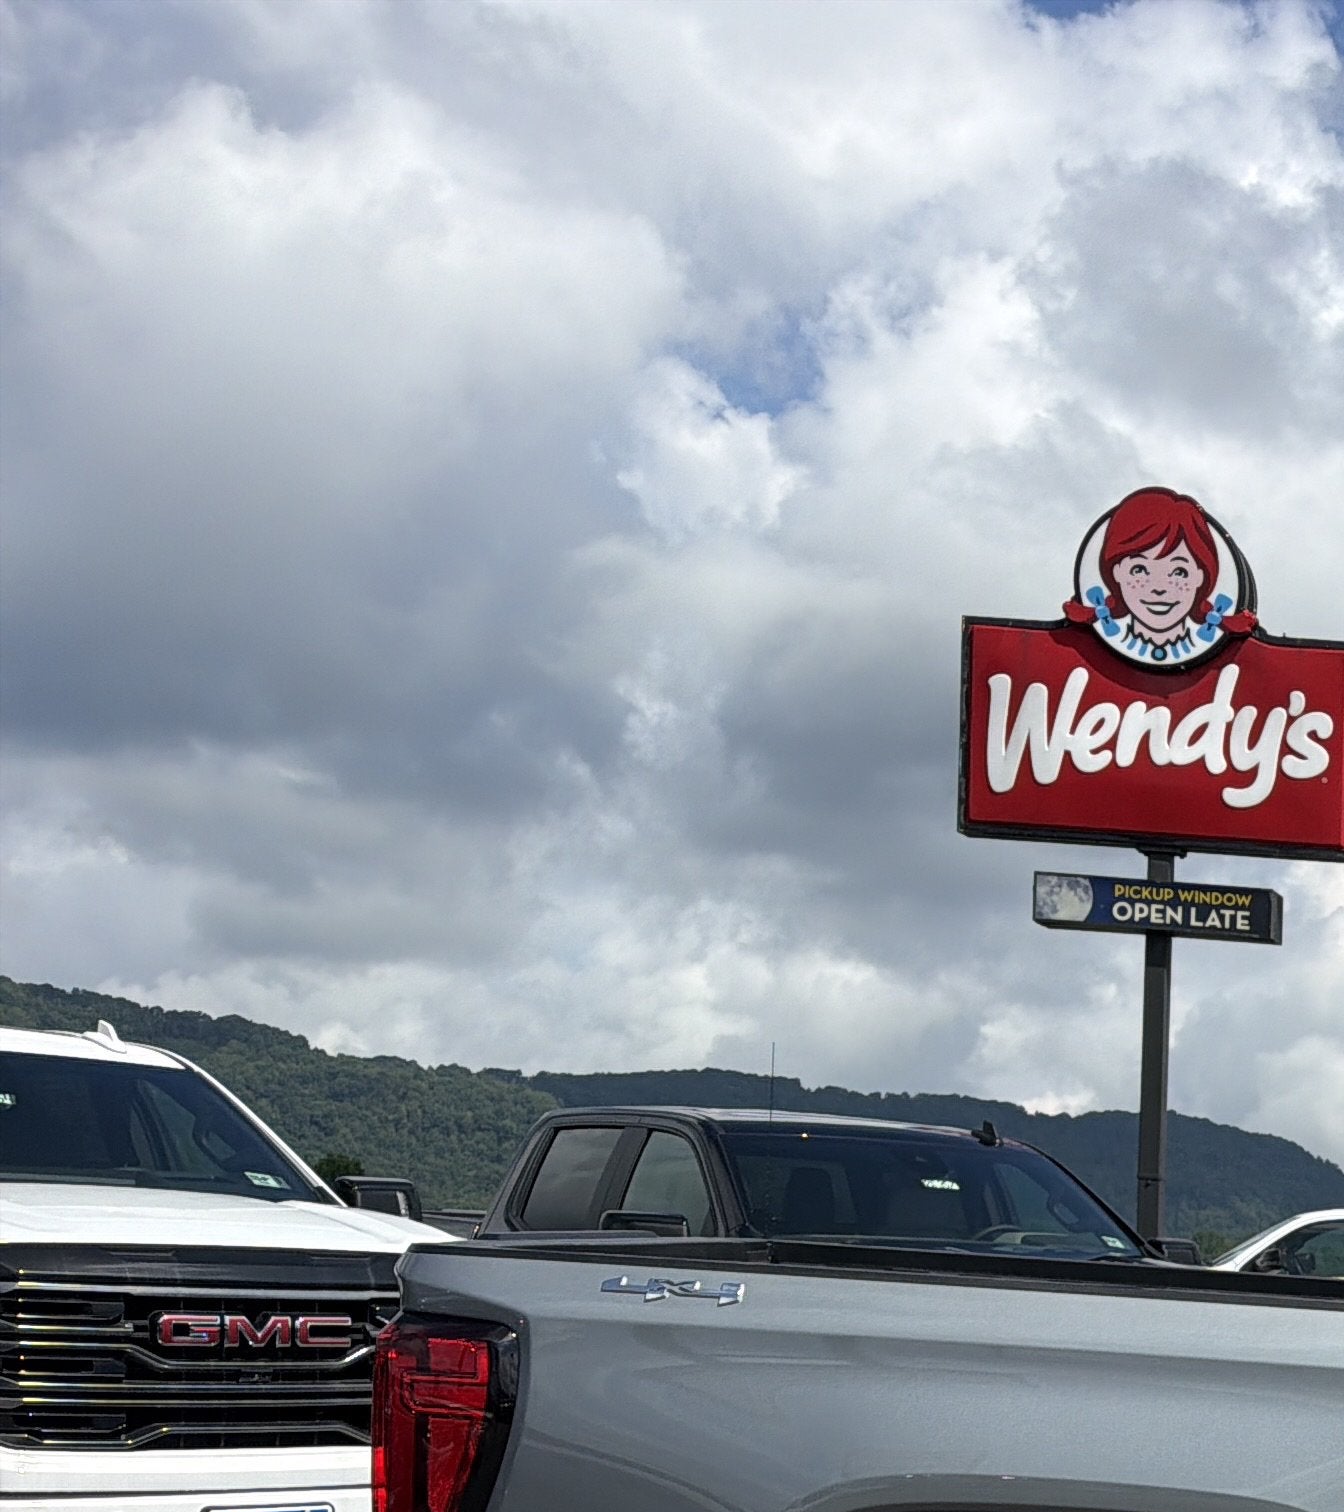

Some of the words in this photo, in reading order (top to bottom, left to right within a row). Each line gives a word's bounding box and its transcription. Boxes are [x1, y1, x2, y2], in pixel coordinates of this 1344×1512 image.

[987, 664, 1334, 808] Wendy's
[1113, 883, 1174, 901] PICKUP
[1178, 889, 1252, 907] WINDOW
[1111, 901, 1183, 925] OPEN
[1189, 907, 1251, 931] LATE
[157, 1314, 351, 1348] GMC
